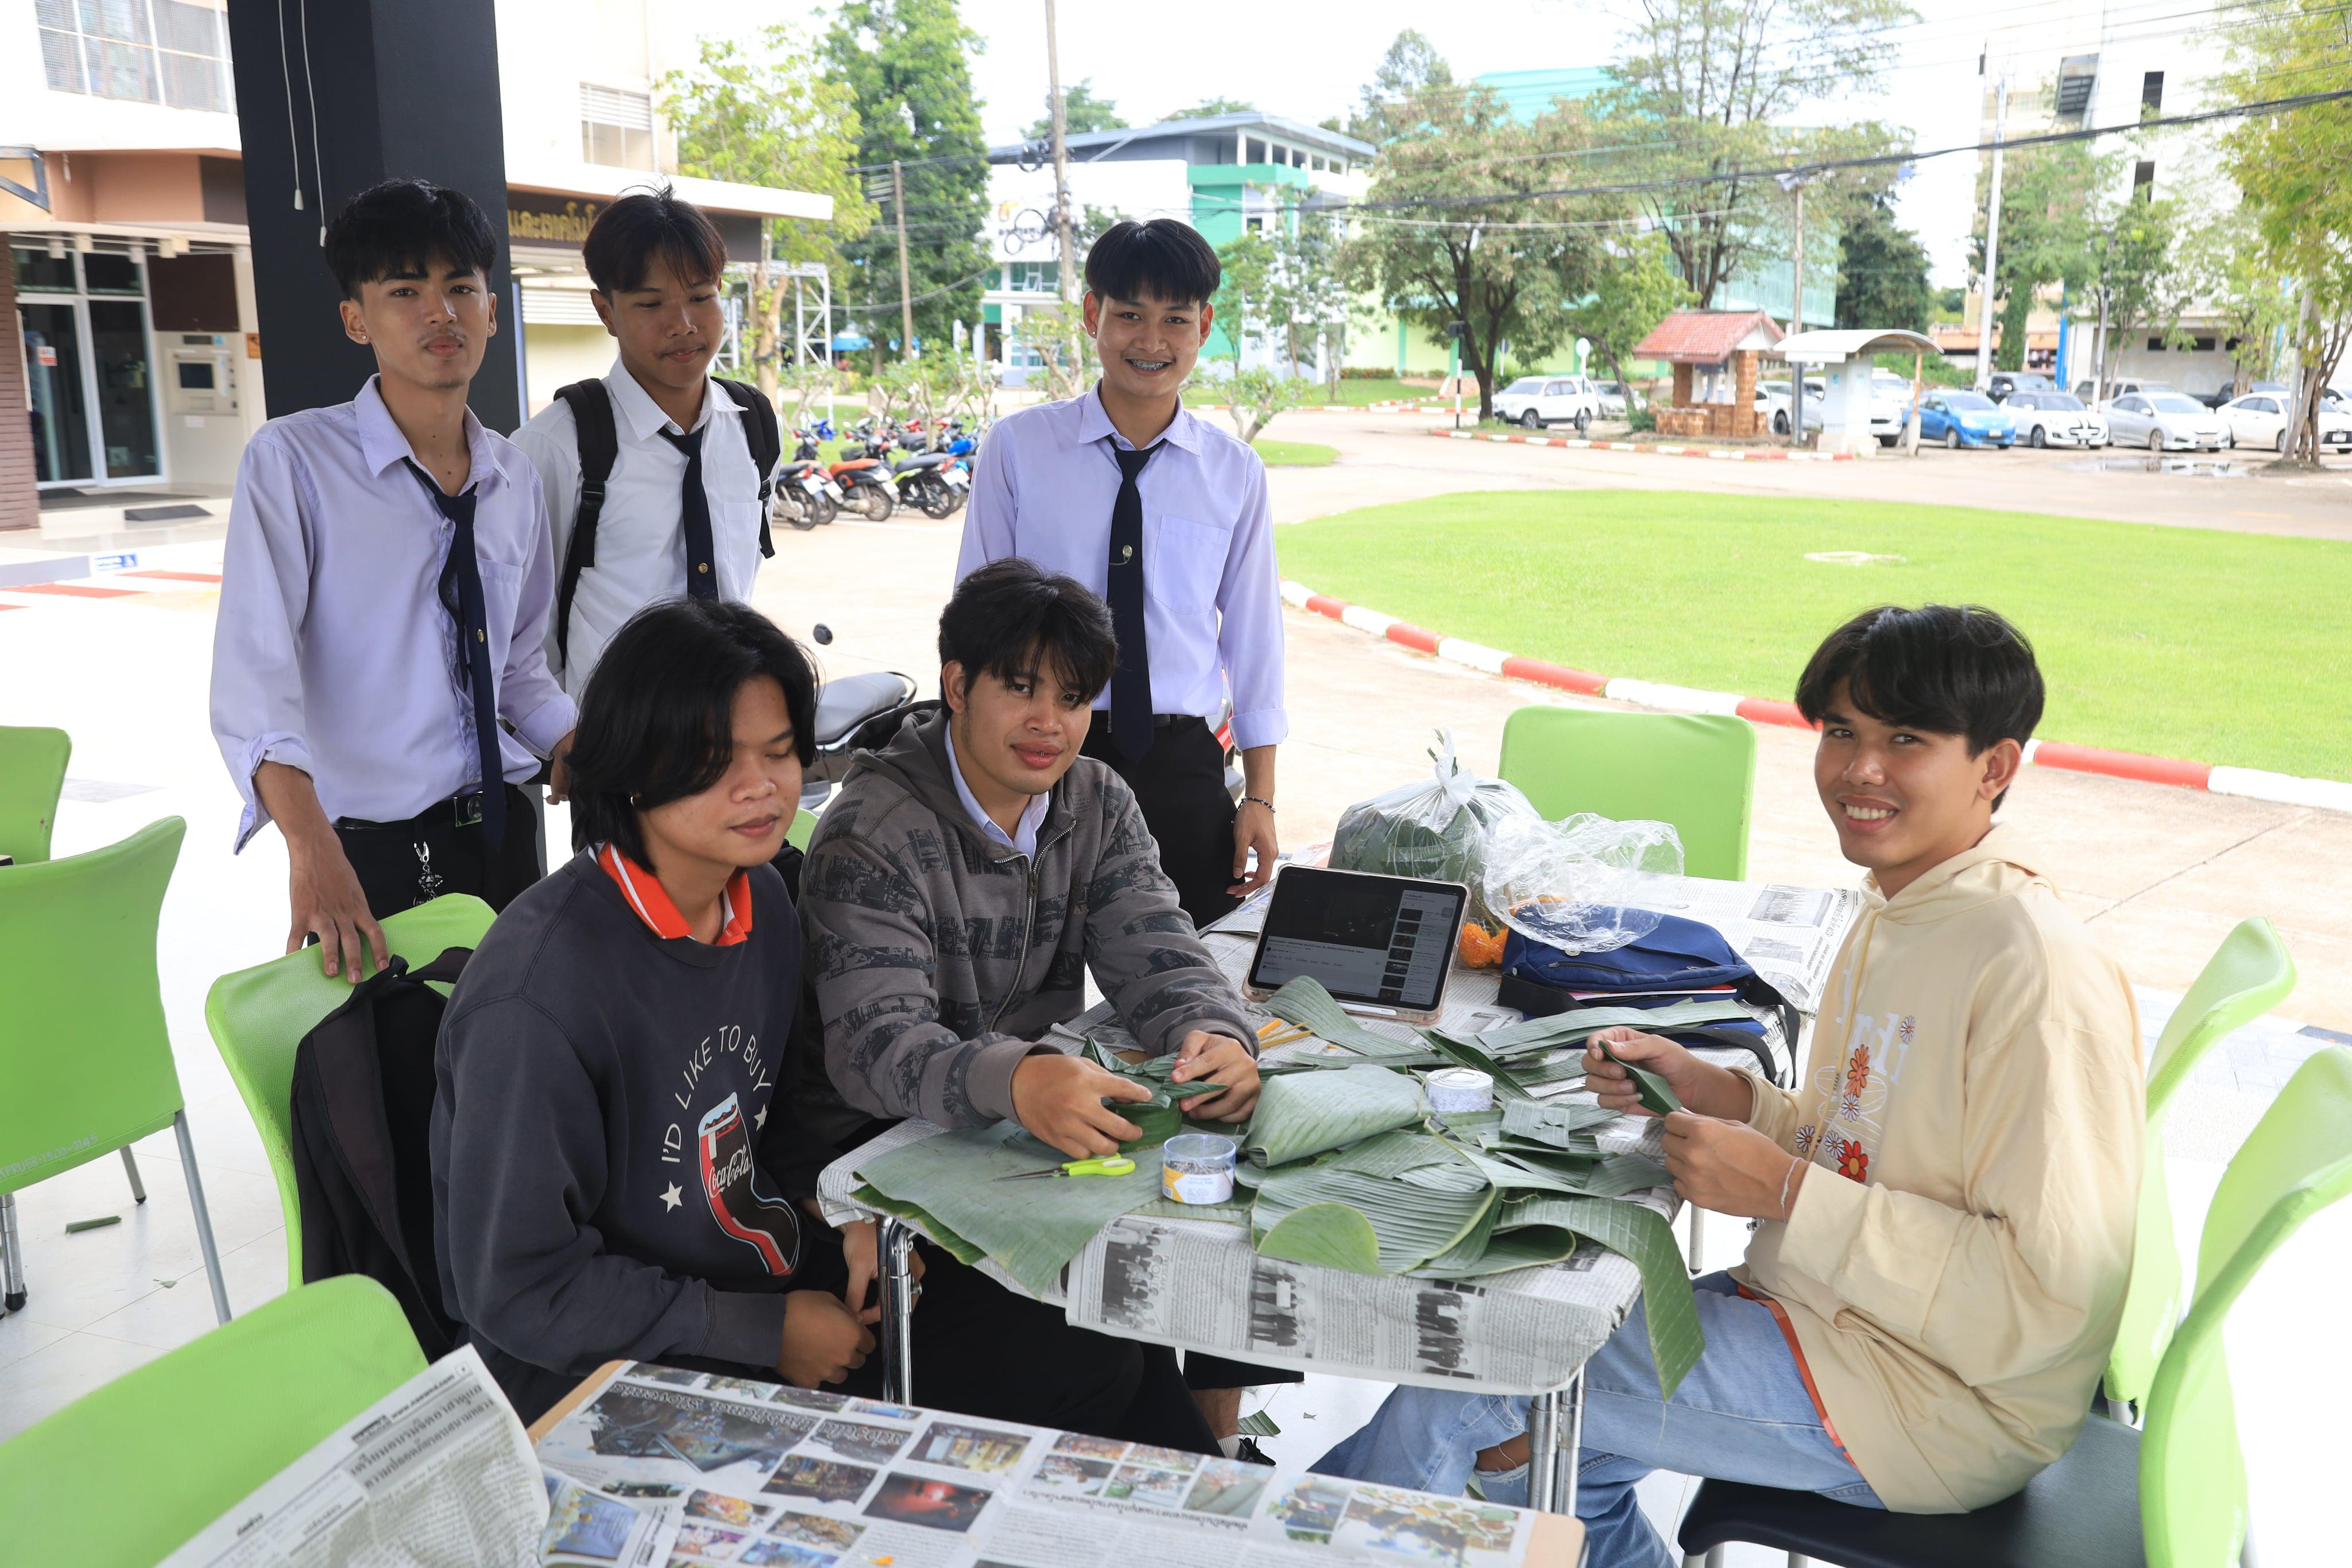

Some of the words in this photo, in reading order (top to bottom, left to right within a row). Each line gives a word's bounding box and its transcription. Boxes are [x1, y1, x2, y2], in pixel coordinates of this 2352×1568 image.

[662, 1123, 682, 1163] I'D
[675, 1036, 712, 1110] LIKE
[719, 1025, 741, 1052] TO
[743, 1033, 772, 1092] BUY
[708, 1144, 751, 1199] Coca-Cola
